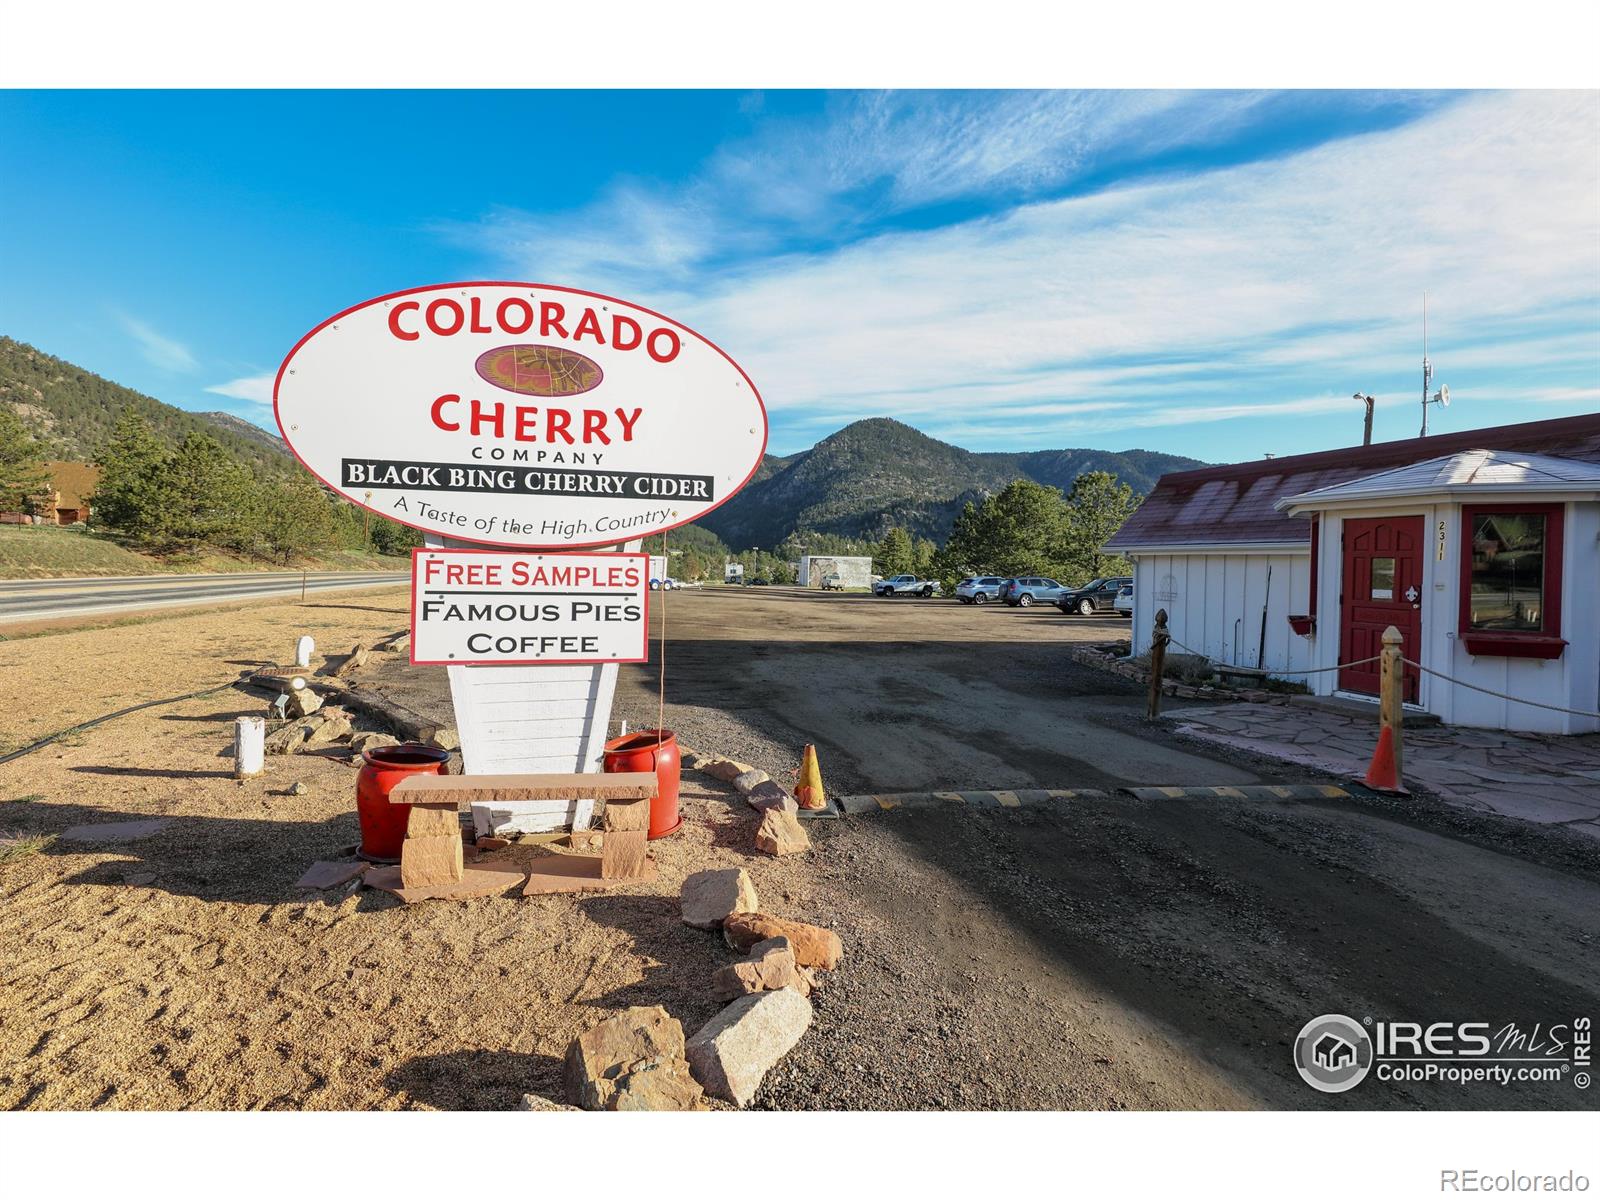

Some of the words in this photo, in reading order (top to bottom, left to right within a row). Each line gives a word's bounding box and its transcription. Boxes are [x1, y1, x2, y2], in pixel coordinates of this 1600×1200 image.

[388, 297, 681, 363] COLORADO
[430, 394, 642, 446] CHERRY
[471, 446, 603, 465] COMPANY
[347, 463, 442, 486] BLACK
[449, 468, 516, 489] BING
[524, 472, 627, 494] CHERRY
[633, 477, 709, 497] CIDER
[393, 495, 409, 512] A
[417, 501, 467, 526] Taste
[474, 516, 498, 534] of
[502, 518, 533, 535] the
[541, 519, 587, 539] High
[595, 507, 671, 532] Country
[1438, 521, 1446, 561] 2311
[425, 559, 502, 585] FREE
[511, 561, 640, 587] SAMPLES
[422, 600, 560, 622] FAMOUS
[571, 602, 641, 622] PIES
[467, 633, 599, 654] COFFEE
